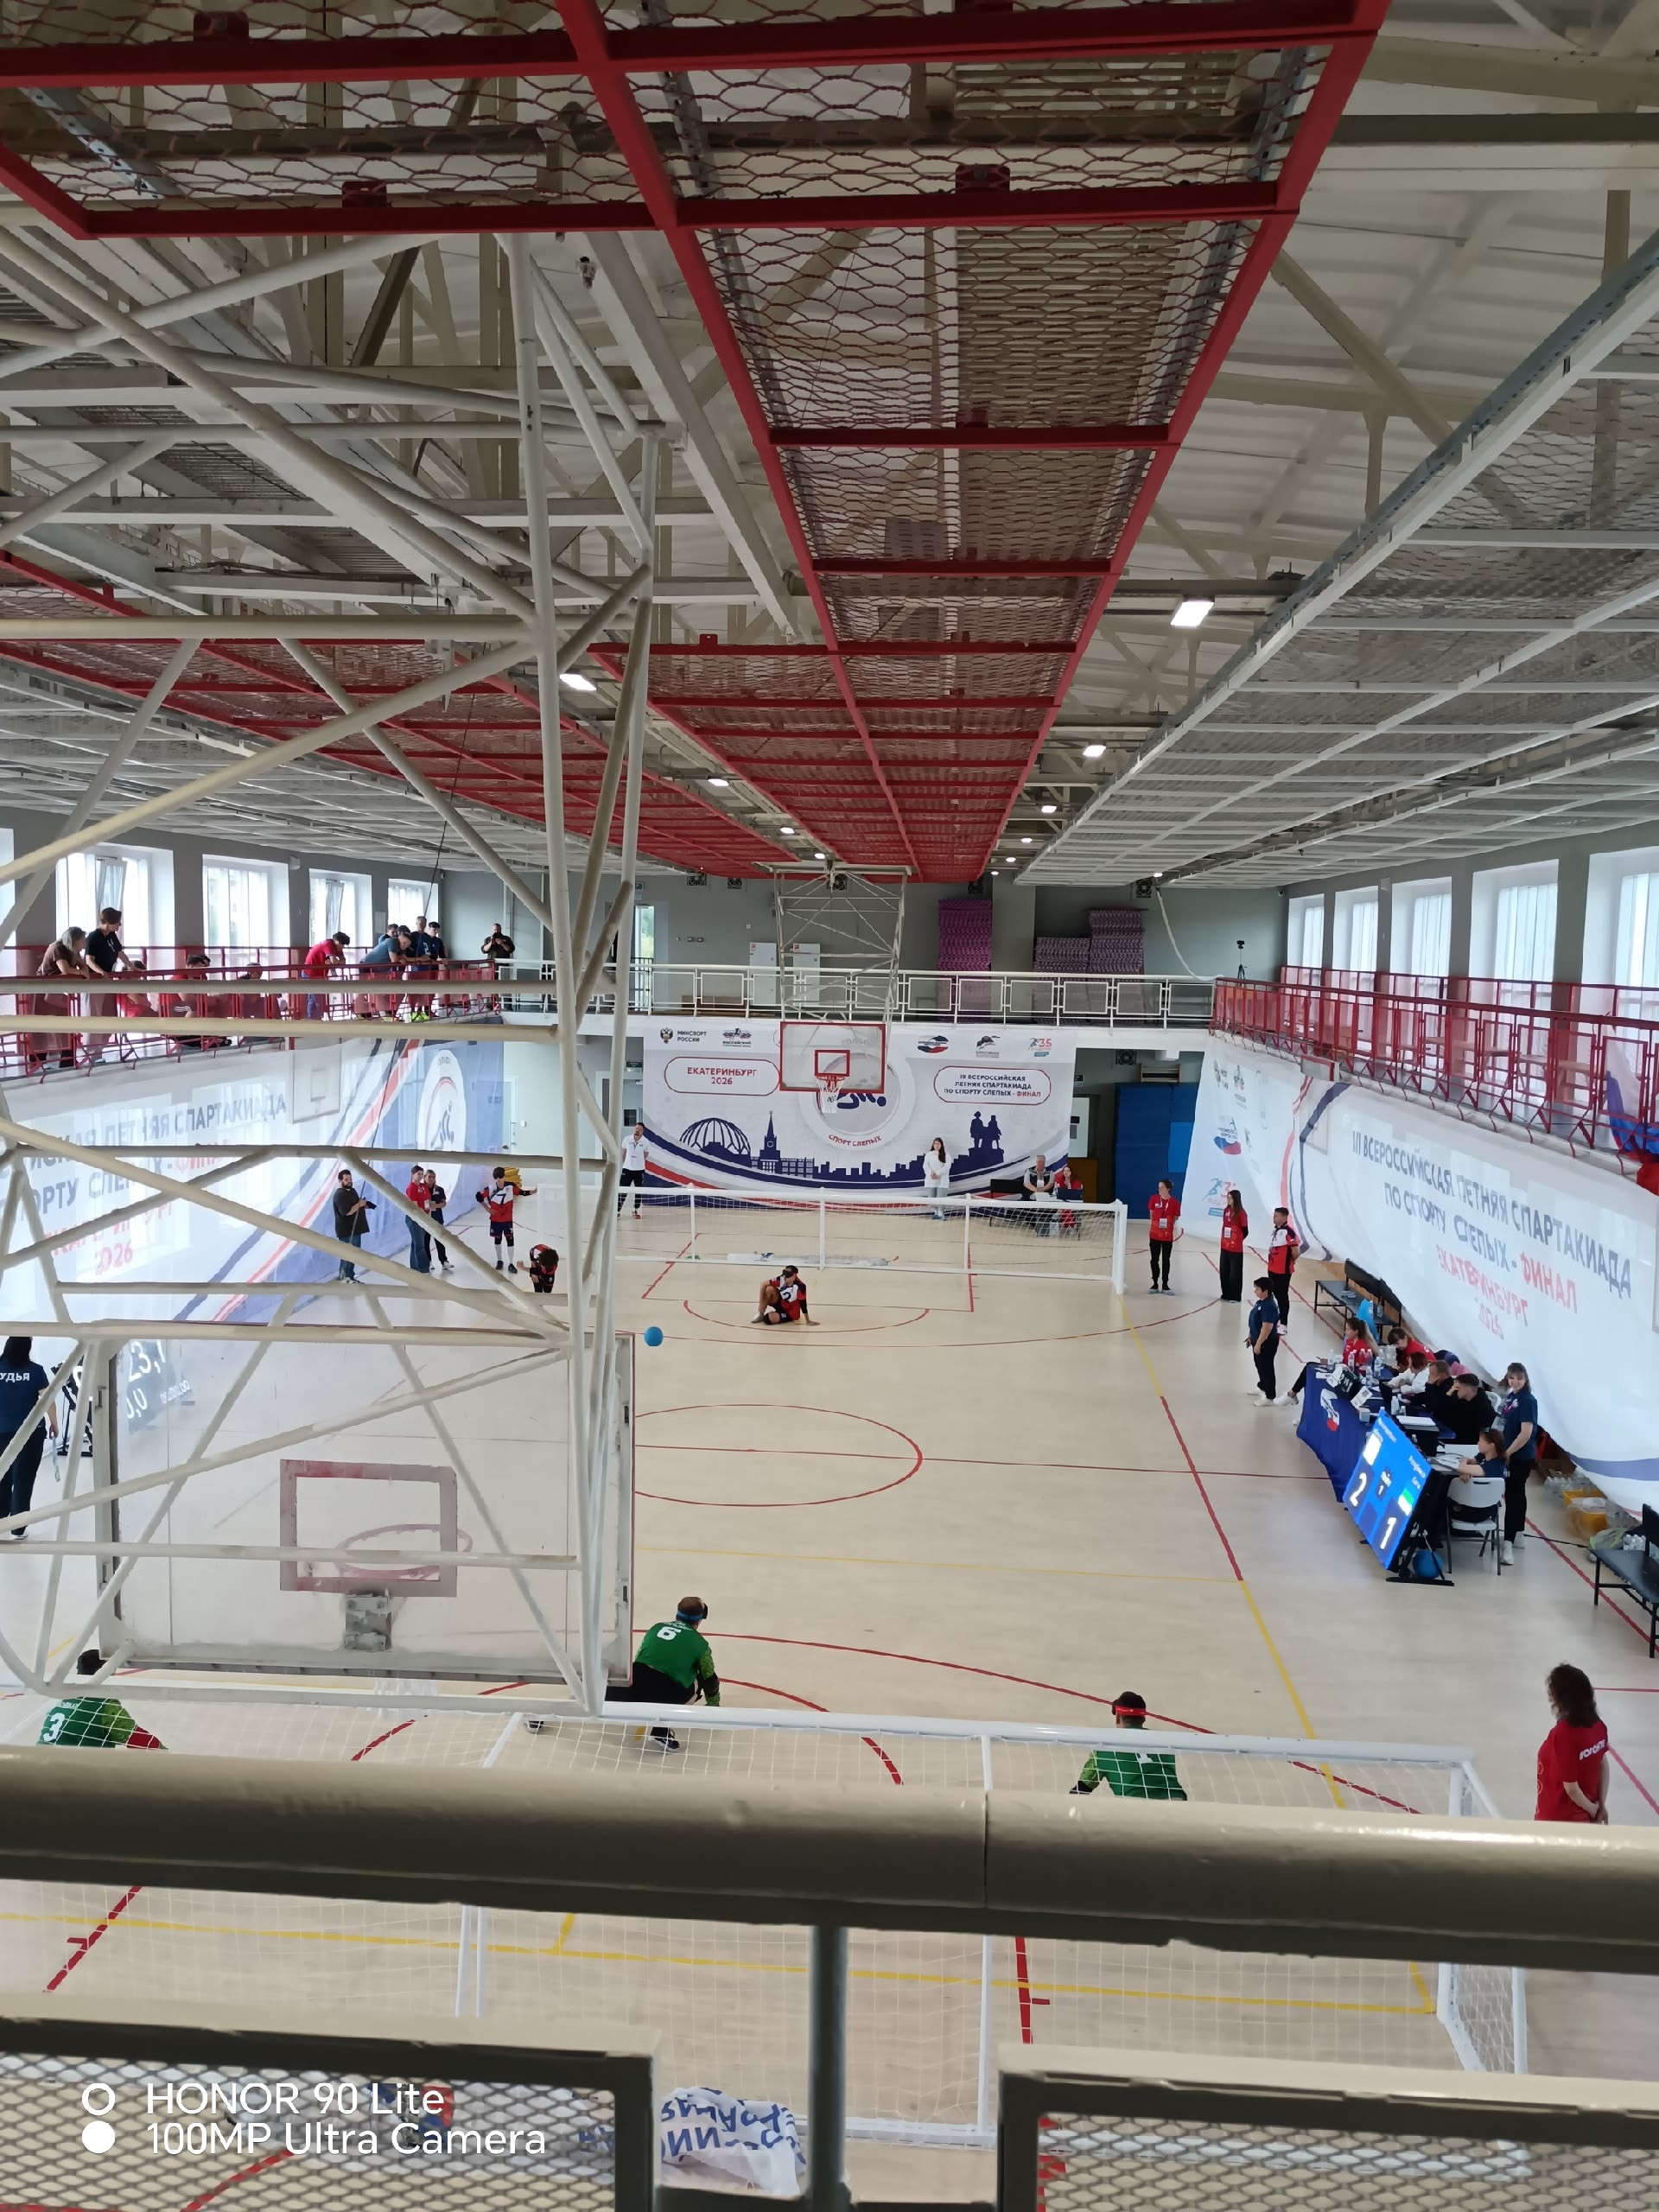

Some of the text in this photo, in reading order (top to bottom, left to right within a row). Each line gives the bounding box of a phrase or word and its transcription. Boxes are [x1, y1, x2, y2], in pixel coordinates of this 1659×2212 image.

[687, 1067, 757, 1077] ЕКАТЕРИНБУРГ
[175, 1092, 287, 1135] СПАРТАКИАДА
[829, 1134, 881, 1147] СПОРТ СЛЕПЫХ
[497, 1193, 506, 1205] 7
[1363, 1135, 1455, 1198] ВСЕРОССИЙСКАЯ
[1456, 1174, 1510, 1225] ЛЕТНЯЯ
[1511, 1199, 1632, 1300] СПАРТАКИАДА
[1384, 1182, 1402, 1210] ПО
[1403, 1190, 1446, 1234] СПОРТУ
[1520, 1252, 1578, 1314] ФИНАЛ
[0, 1372, 30, 1382] УДЬЯ
[1350, 1472, 1367, 1507] 2
[1380, 1517, 1397, 1549] 1
[657, 1626, 682, 1641] 6
[43, 1713, 65, 1742] 3
